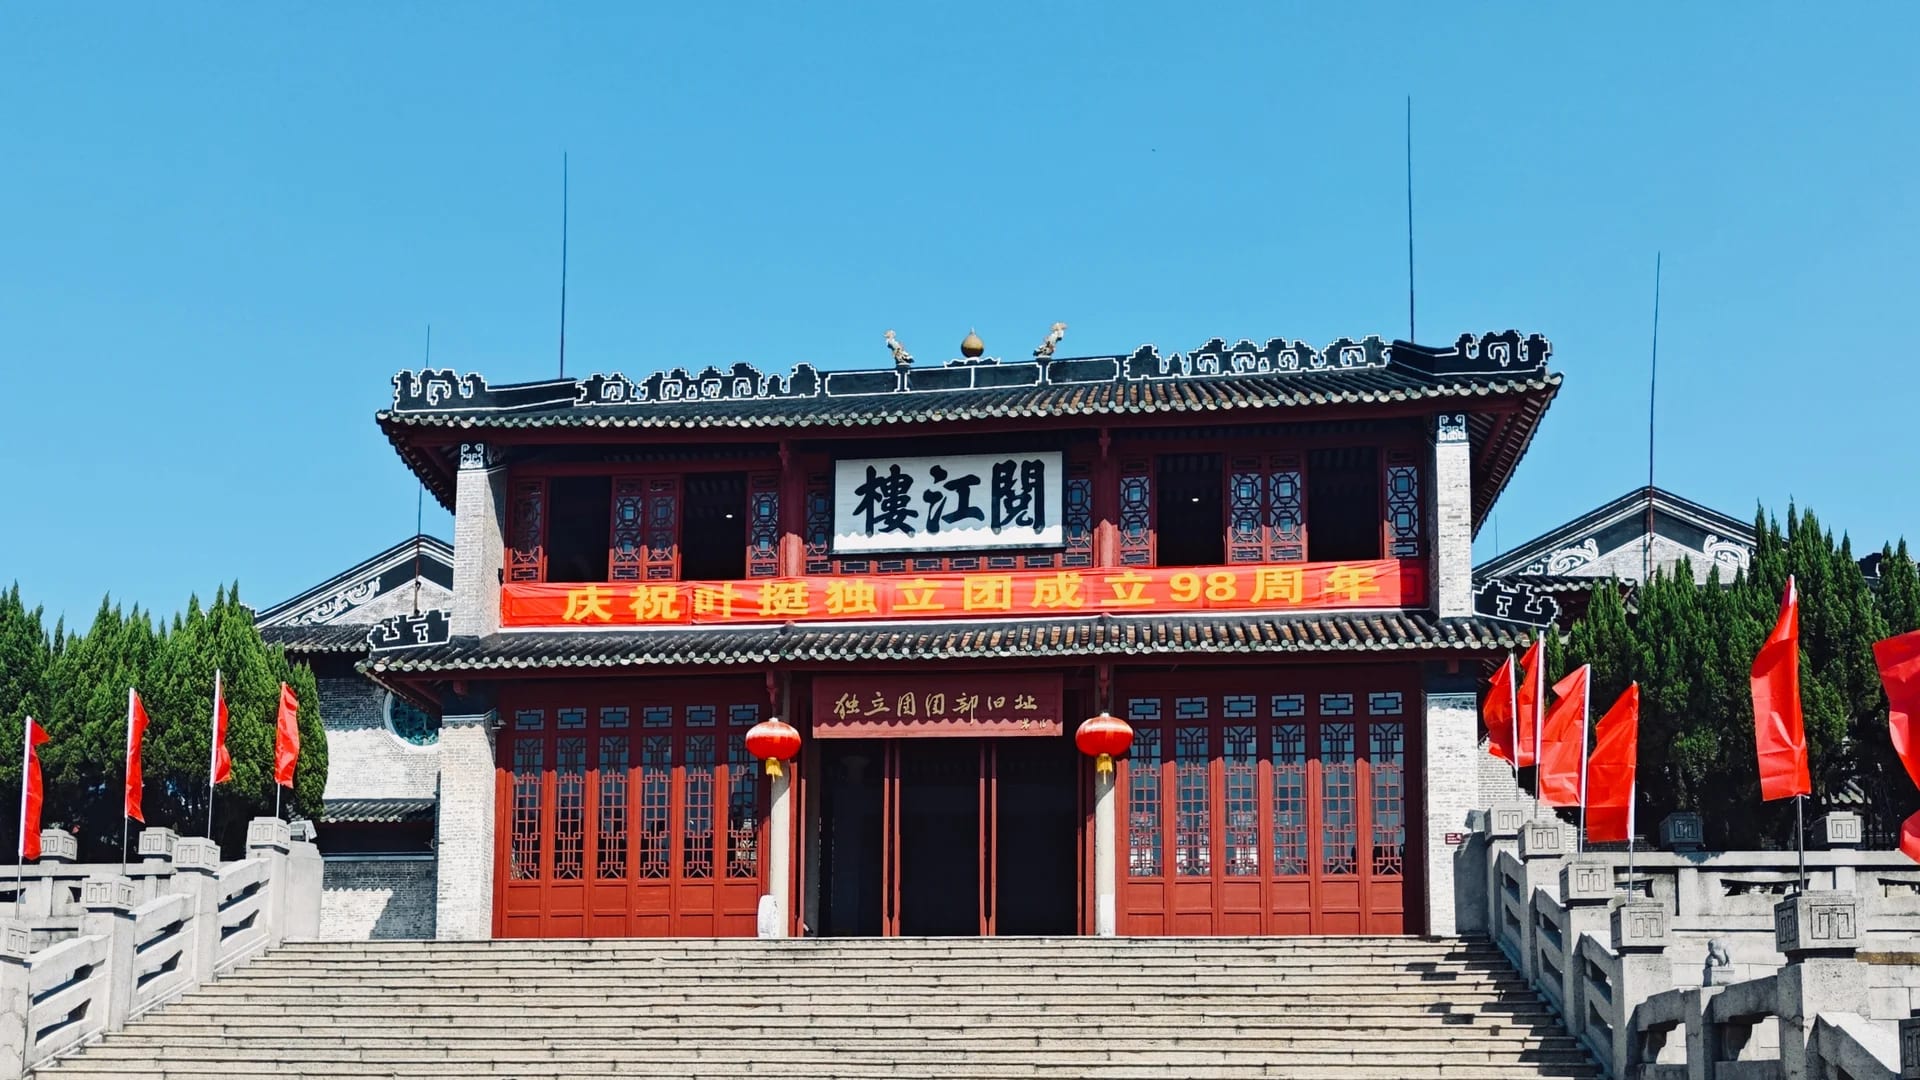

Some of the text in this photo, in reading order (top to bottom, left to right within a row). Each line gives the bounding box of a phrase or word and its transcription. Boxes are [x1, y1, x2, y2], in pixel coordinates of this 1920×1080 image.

[562, 565, 1381, 622] 庆祝叶挺独立团成立98周年
[833, 691, 1038, 726] 独立团团部旧址
